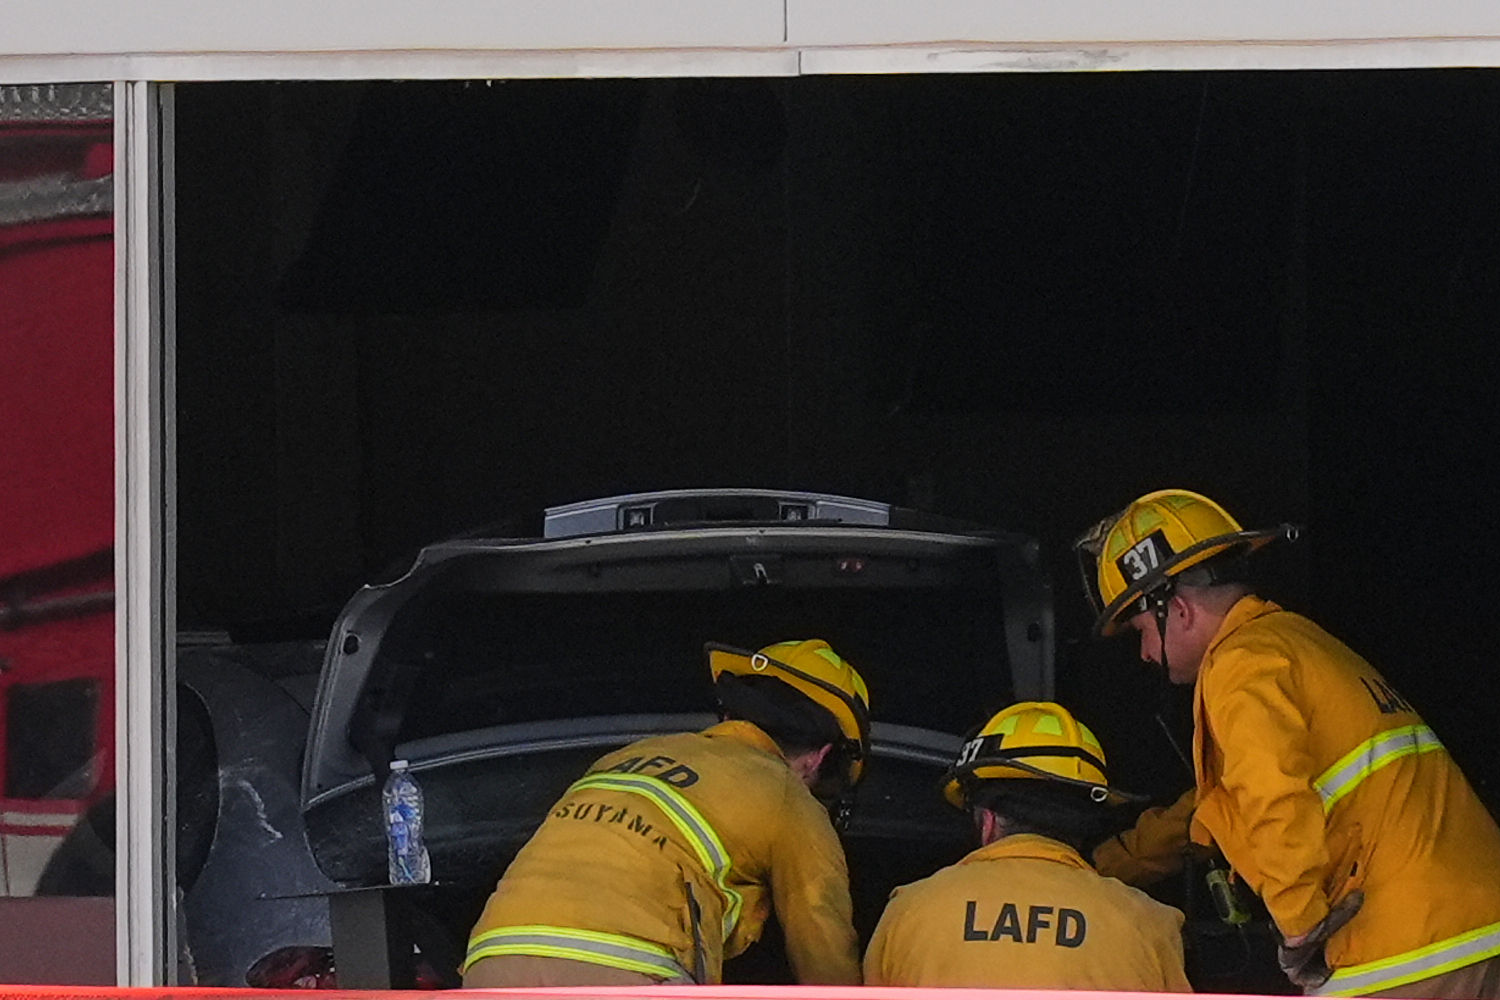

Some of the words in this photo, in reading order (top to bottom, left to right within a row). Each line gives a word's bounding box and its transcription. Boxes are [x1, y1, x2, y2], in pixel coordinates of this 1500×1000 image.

[1123, 537, 1160, 580] 37
[955, 737, 986, 767] 37
[555, 803, 668, 851] SUYAMA
[963, 900, 1087, 949] LAFD
